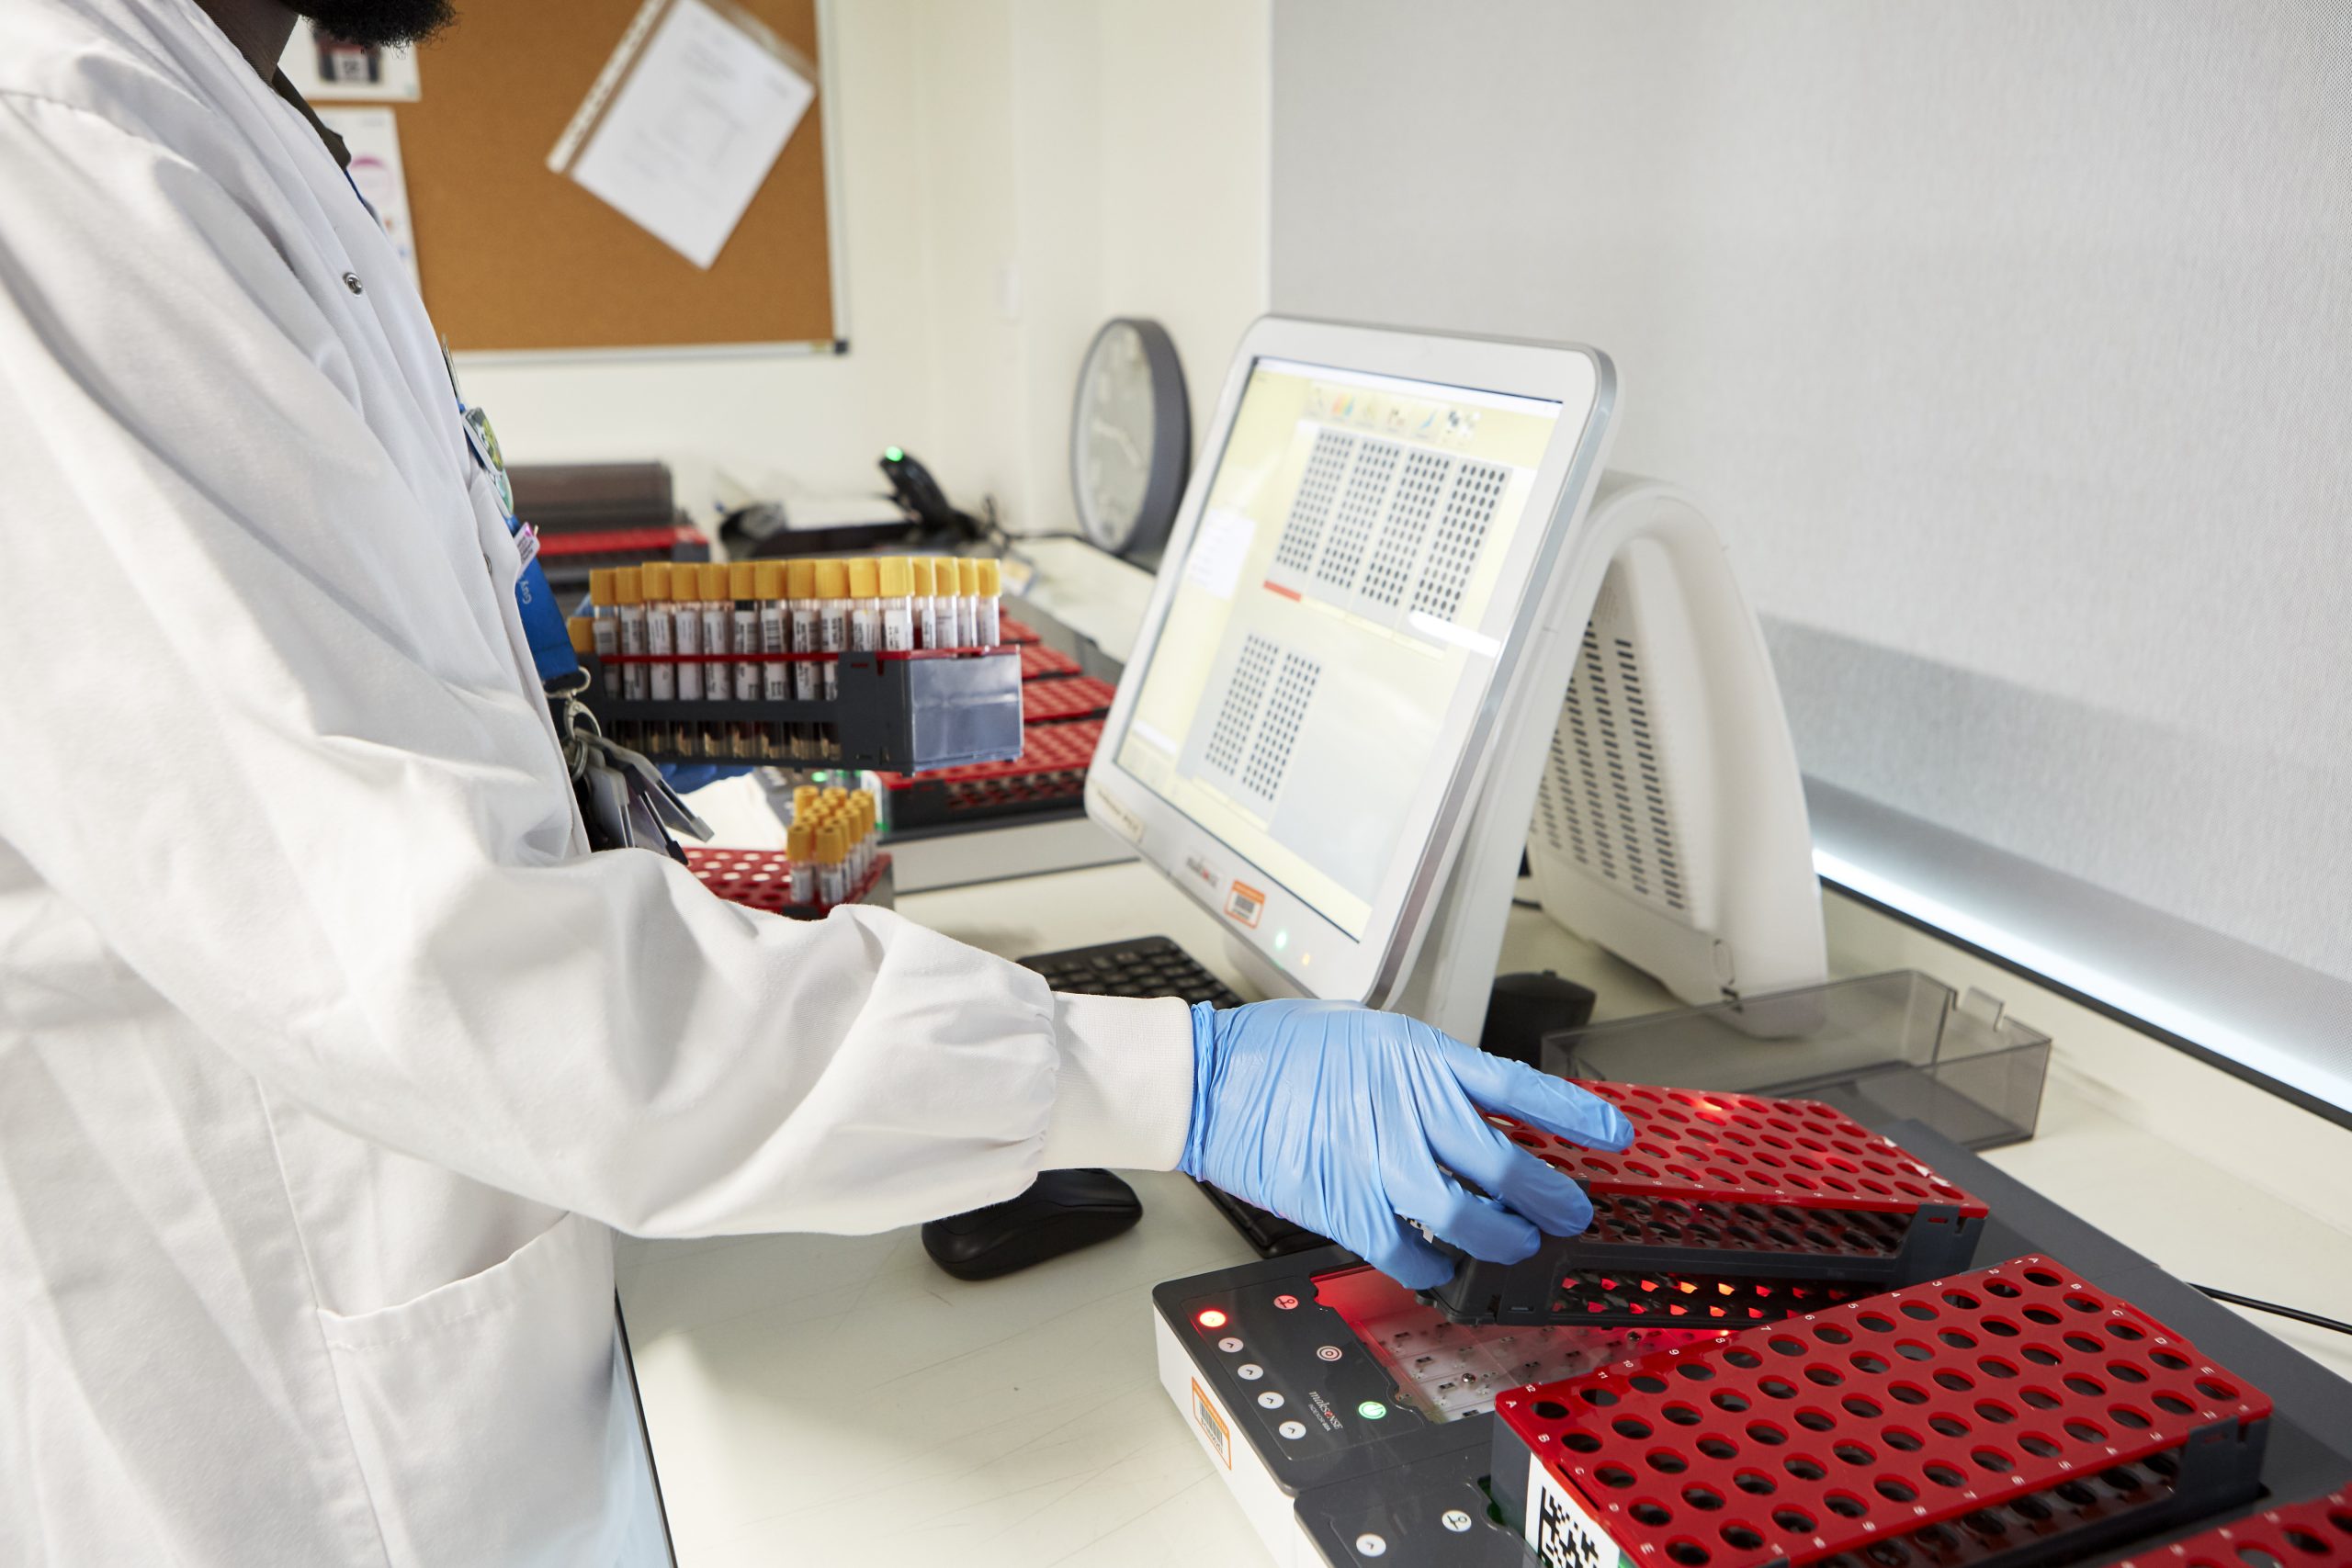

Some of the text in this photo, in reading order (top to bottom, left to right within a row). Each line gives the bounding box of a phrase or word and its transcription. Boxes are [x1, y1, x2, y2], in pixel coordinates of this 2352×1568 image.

[2111, 1309, 2124, 1317] C
[2154, 1337, 2168, 1345] D
[2200, 1366, 2215, 1375] E
[1505, 1400, 1655, 1555] A B C D E
